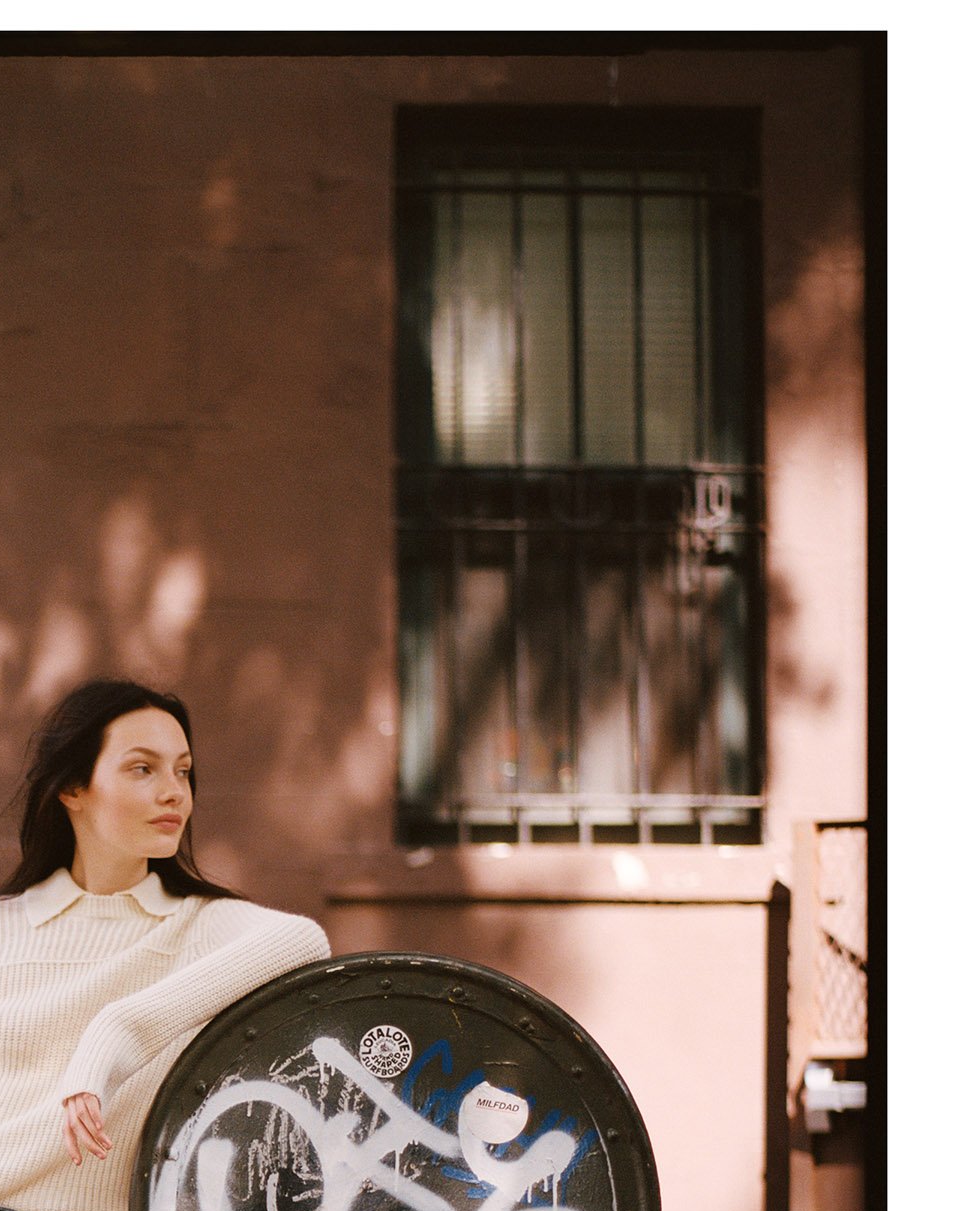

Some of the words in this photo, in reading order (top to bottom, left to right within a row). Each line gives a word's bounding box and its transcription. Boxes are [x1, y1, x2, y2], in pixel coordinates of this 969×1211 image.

[361, 1027, 411, 1055] LOTALOTE
[361, 1053, 411, 1077] SURFBOARDS
[372, 1052, 402, 1068] SHAPED
[476, 1098, 520, 1112] MILFDAD
